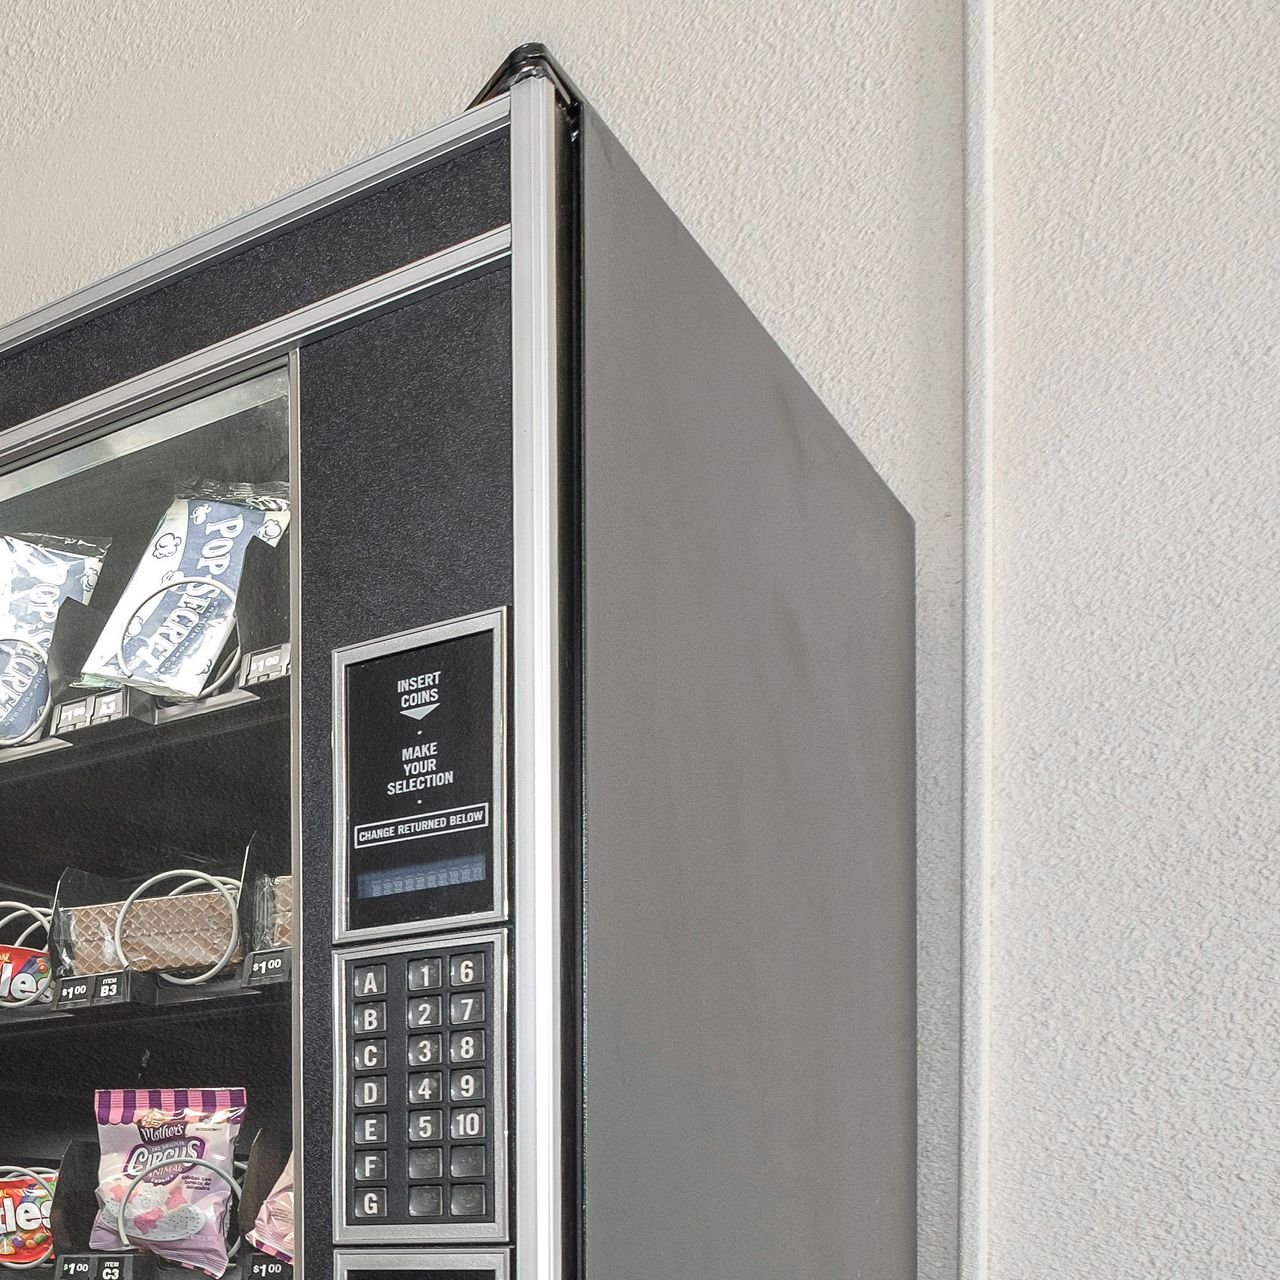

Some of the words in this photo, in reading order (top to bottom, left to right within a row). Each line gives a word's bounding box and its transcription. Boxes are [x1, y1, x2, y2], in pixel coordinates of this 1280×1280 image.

[196, 514, 244, 575] POP
[397, 671, 441, 693] INSERT
[401, 688, 439, 708] COINS
[401, 742, 438, 761] MAKE
[403, 760, 437, 776] YOUR
[387, 771, 454, 795] SELECTION
[358, 826, 395, 842] CHANGE
[398, 817, 446, 836] RETURNED
[449, 810, 483, 826] BELOW
[421, 965, 430, 986] 1
[460, 961, 474, 982] 6
[100, 985, 117, 997] B3
[363, 973, 378, 994] A
[364, 1009, 378, 1031] B
[418, 1004, 431, 1025] 2
[460, 999, 474, 1020] 7
[364, 1045, 378, 1067] C
[419, 1040, 431, 1062] 3
[460, 1036, 474, 1059] 8
[364, 1082, 377, 1104] D
[418, 1078, 432, 1099] 4
[460, 1075, 474, 1097] 9
[141, 1124, 185, 1141] Mother's
[365, 1119, 377, 1141] E
[419, 1116, 432, 1138] 5
[456, 1113, 479, 1135] 10
[365, 1156, 377, 1178] F
[364, 1193, 378, 1214] G
[102, 1268, 119, 1280] C3
